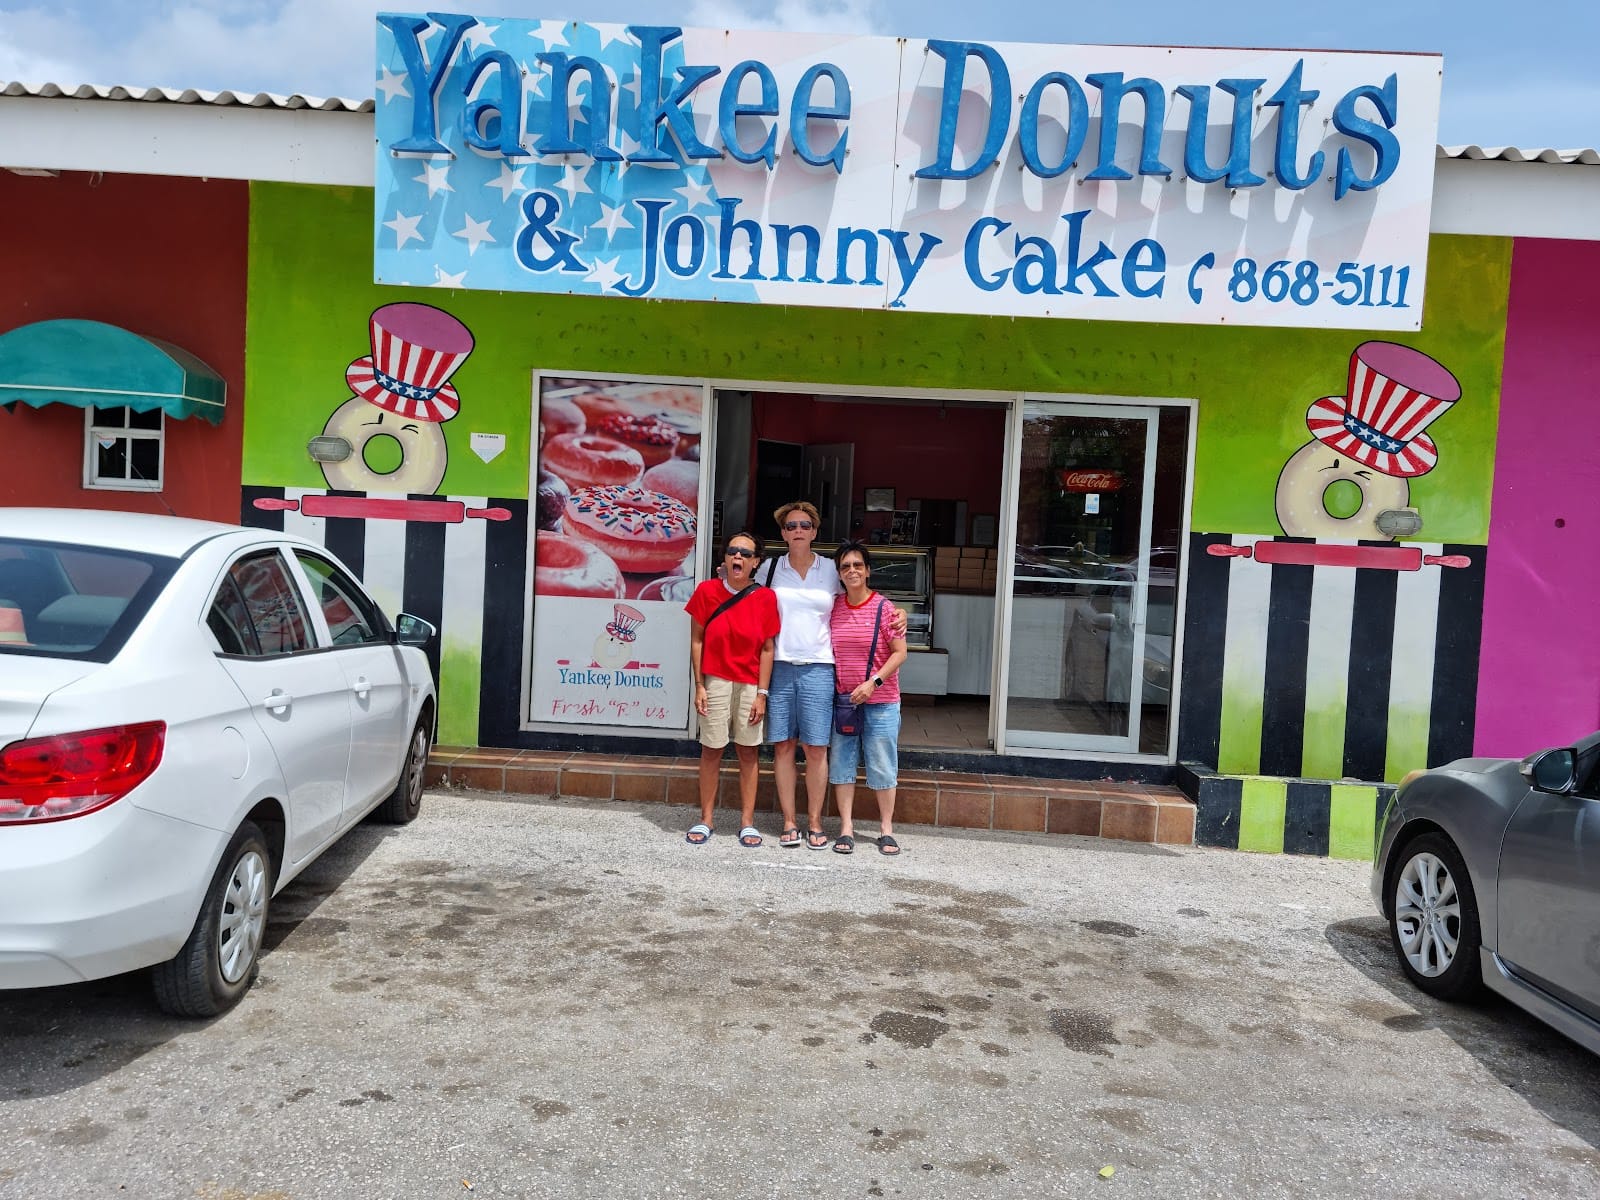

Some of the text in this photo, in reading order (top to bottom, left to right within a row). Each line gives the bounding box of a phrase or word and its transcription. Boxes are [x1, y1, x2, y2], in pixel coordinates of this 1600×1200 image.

[377, 12, 1401, 200] Yankee Donuts
[516, 191, 1410, 308] & Johnny Cake 868-5111
[559, 668, 664, 688] Yankee Donuts
